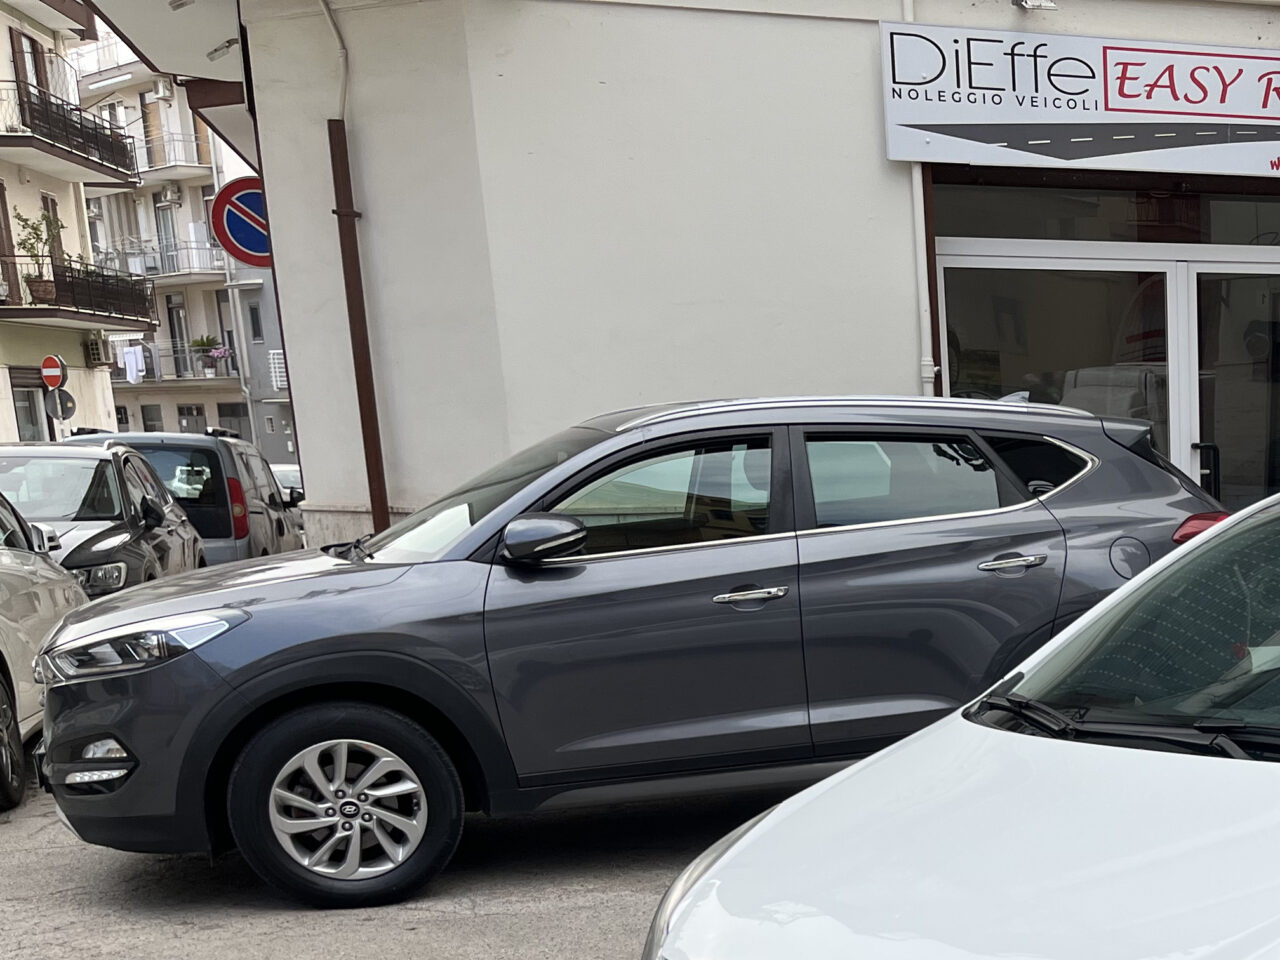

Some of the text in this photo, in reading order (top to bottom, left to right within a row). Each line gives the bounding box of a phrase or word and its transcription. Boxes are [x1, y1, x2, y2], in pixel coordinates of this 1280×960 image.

[889, 31, 1096, 96] DiEffe
[1113, 61, 1244, 105] EASY
[891, 87, 1099, 111] NOLEGGIO VEICOLI
